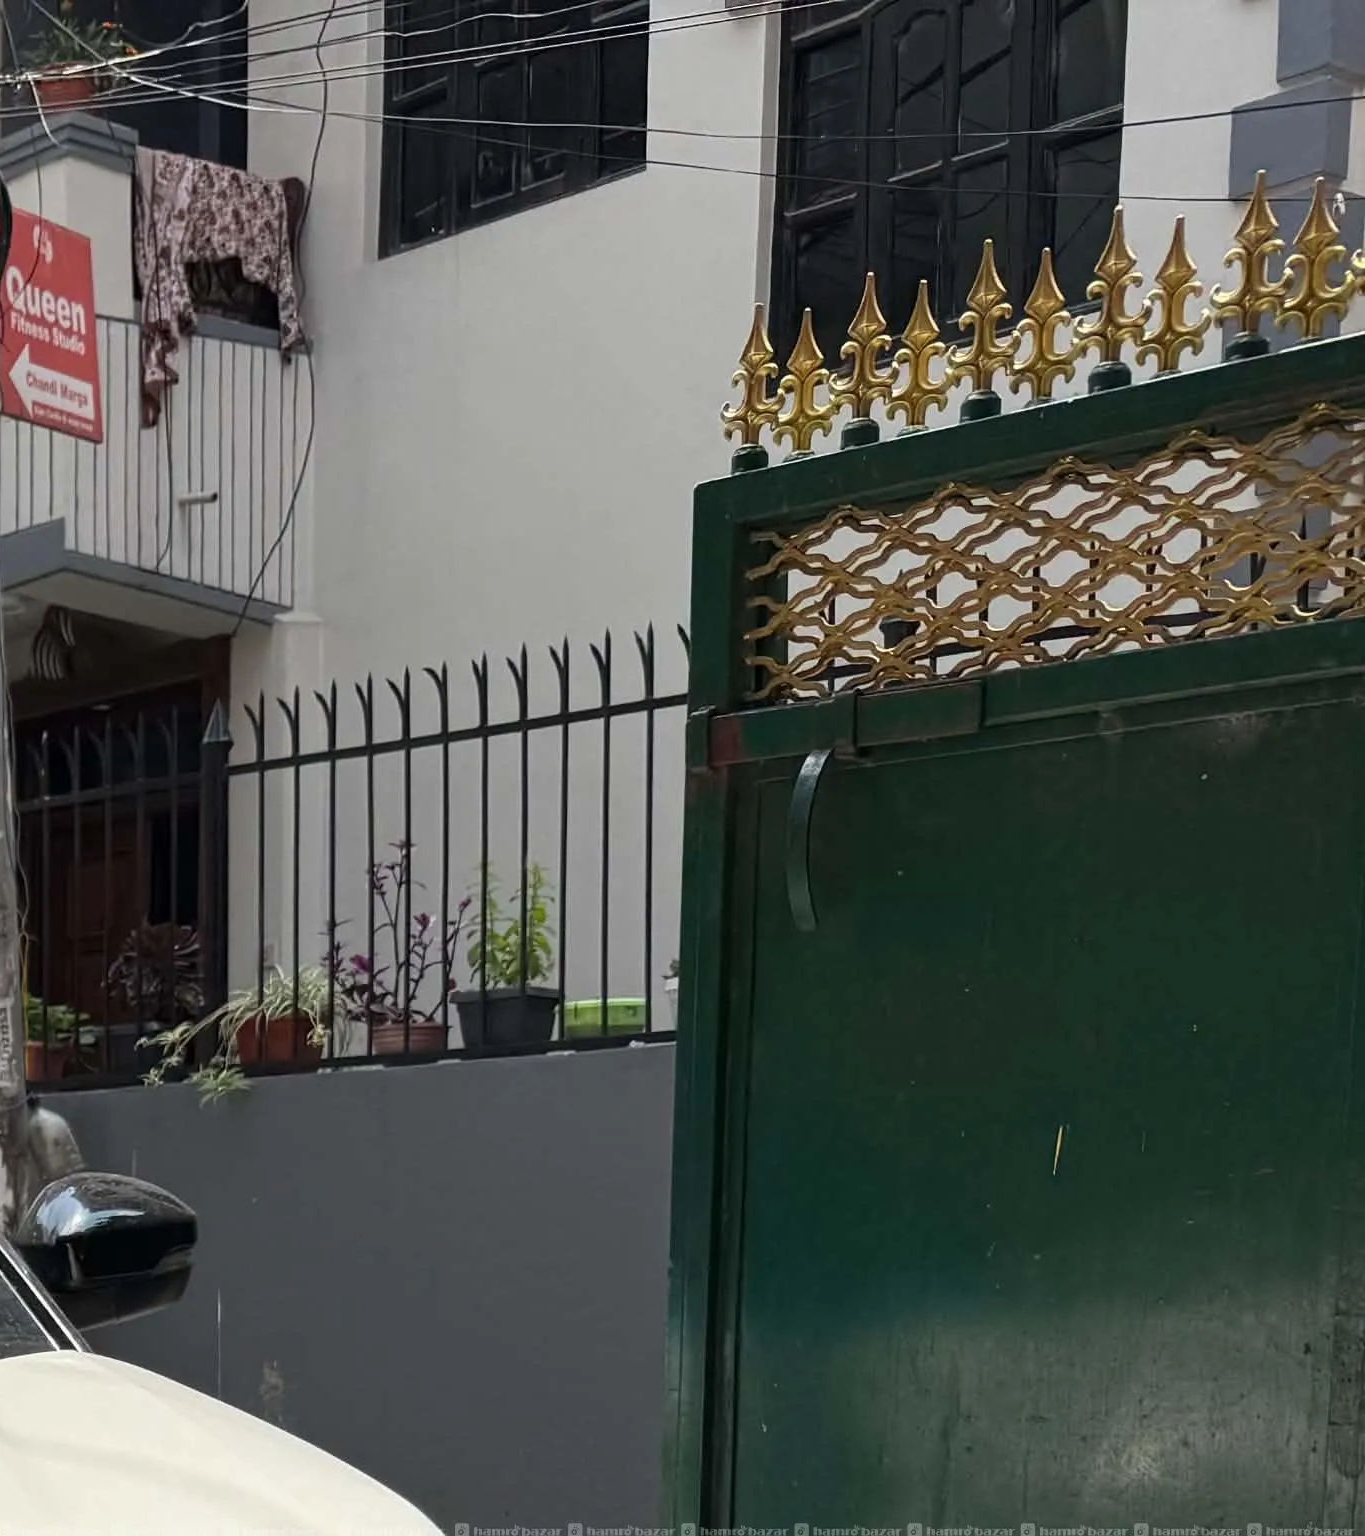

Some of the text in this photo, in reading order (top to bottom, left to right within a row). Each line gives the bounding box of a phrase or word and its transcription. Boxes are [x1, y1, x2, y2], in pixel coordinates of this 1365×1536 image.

[5, 265, 86, 335] Queen
[10, 311, 86, 356] Fitness Studio
